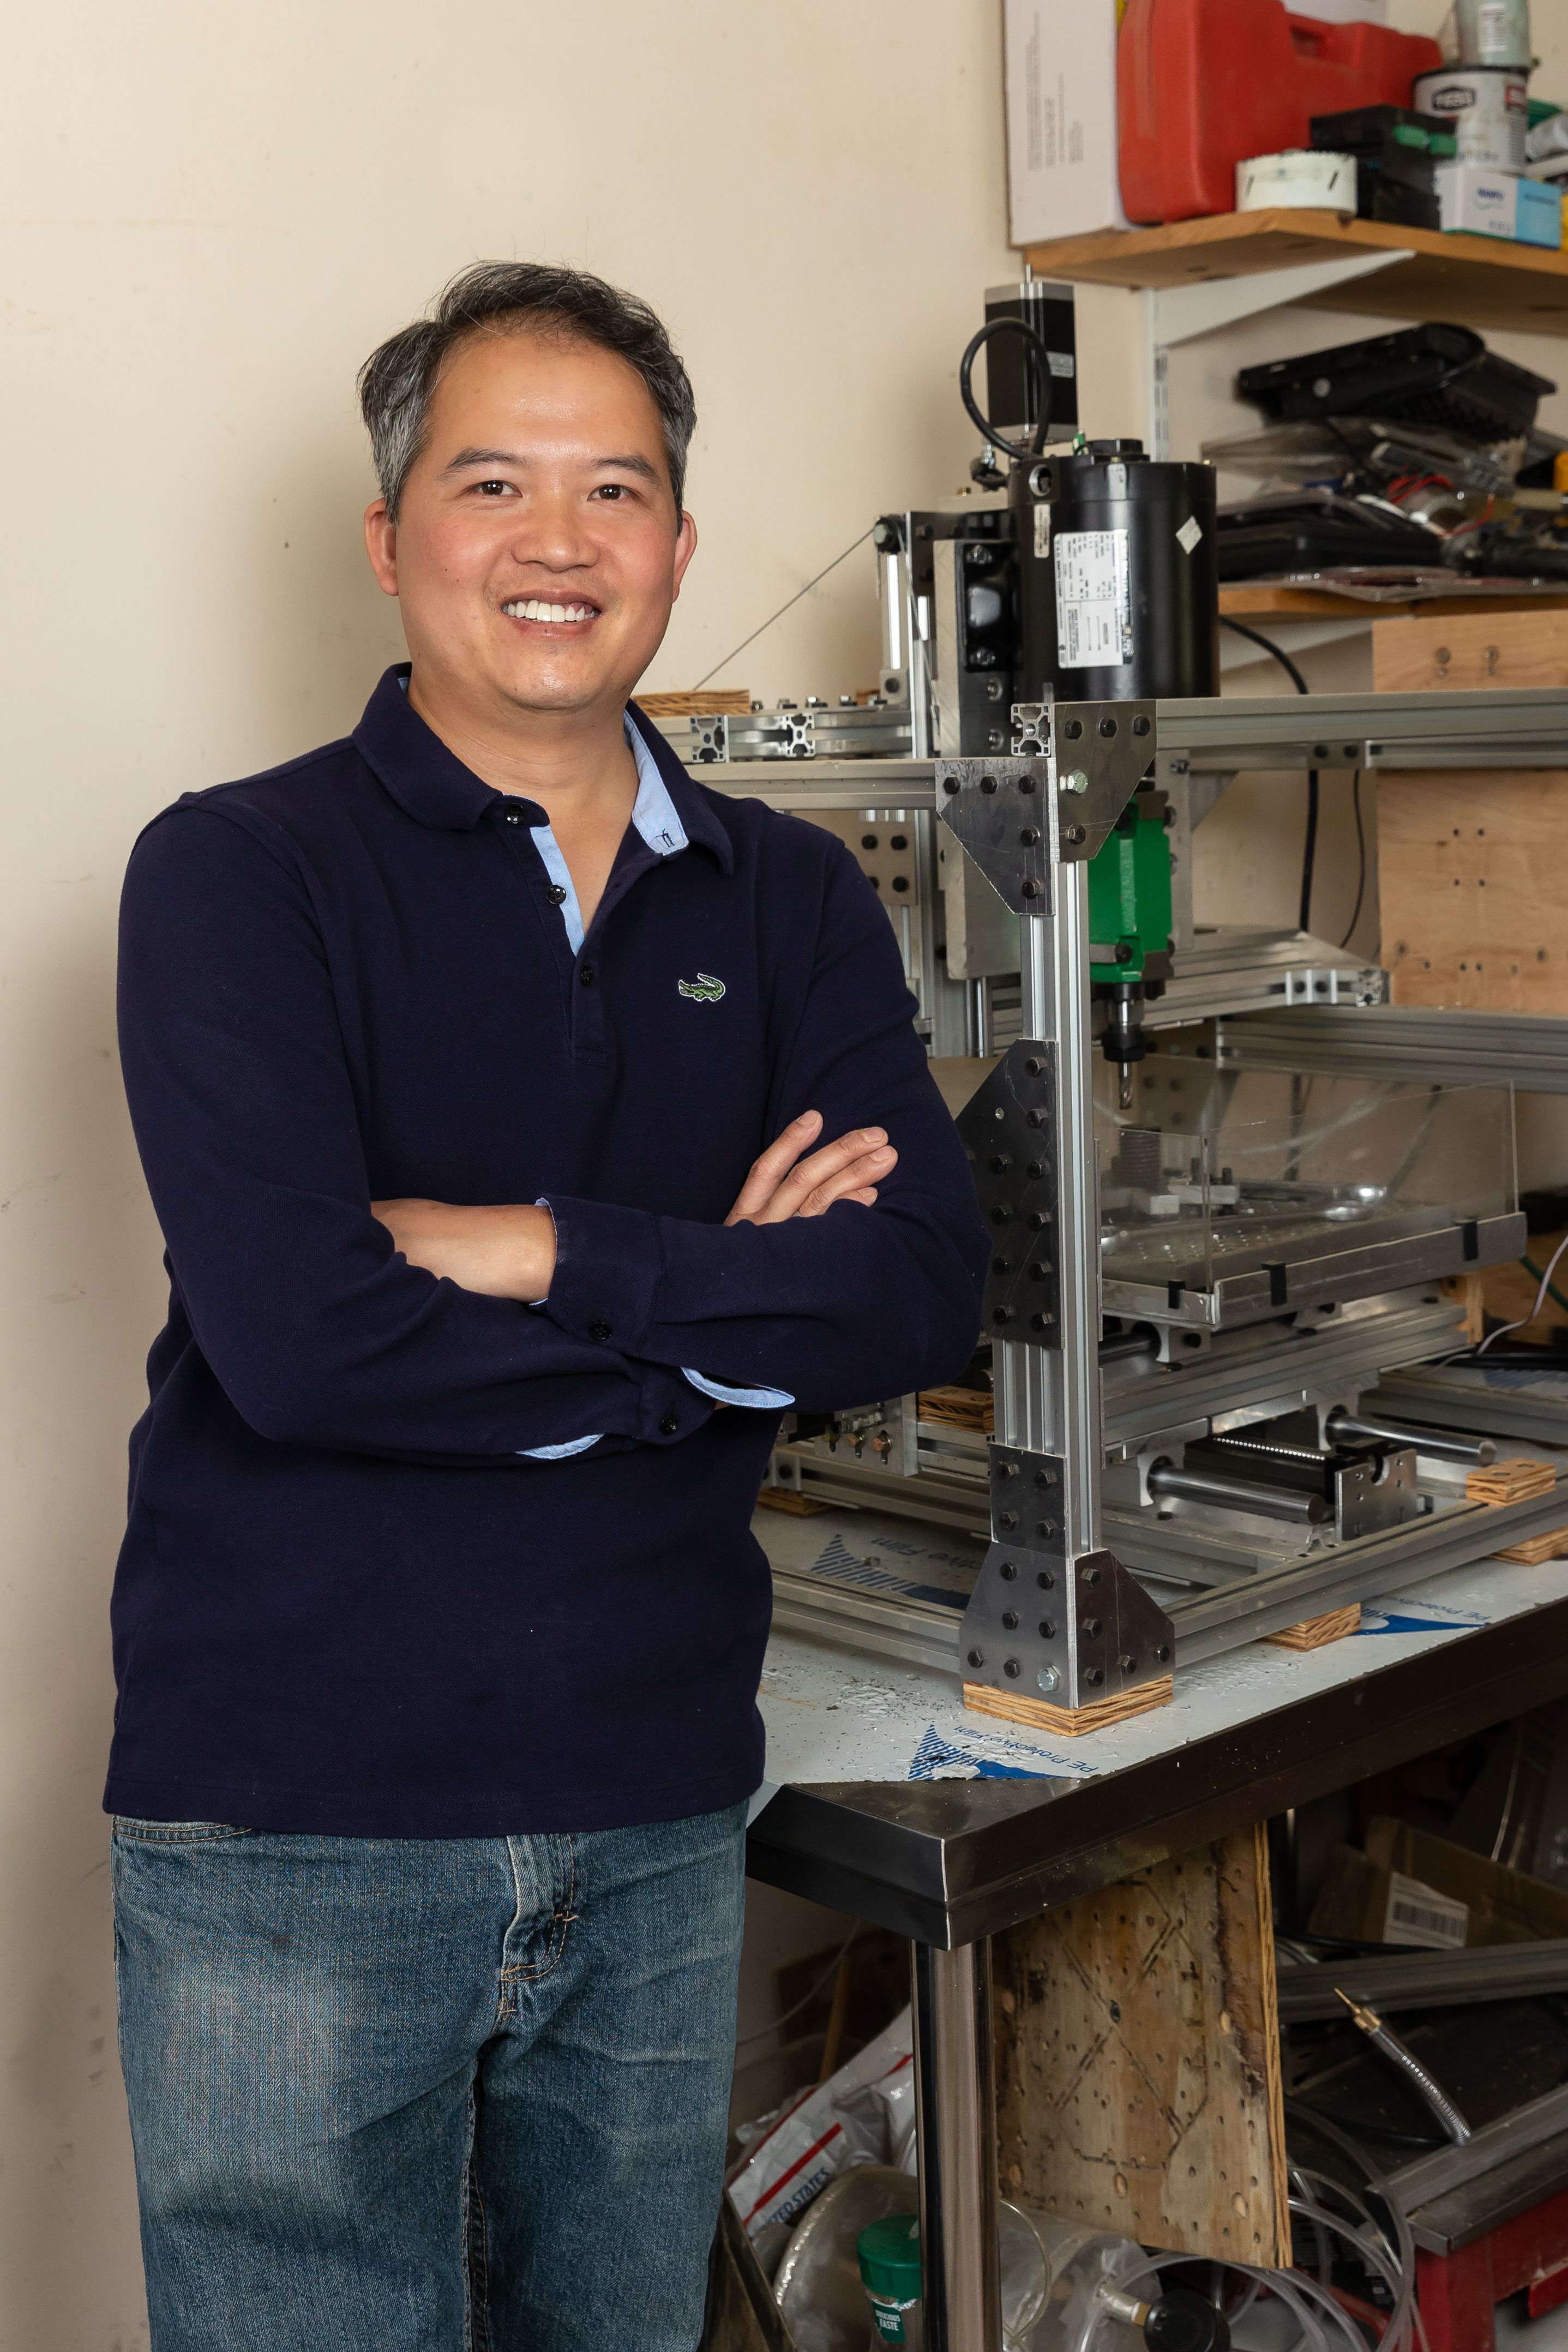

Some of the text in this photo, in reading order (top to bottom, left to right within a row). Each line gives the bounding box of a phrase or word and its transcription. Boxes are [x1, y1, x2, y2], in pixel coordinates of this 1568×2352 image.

[871, 1538, 928, 1556] Film
[1462, 1611, 1493, 1621] PE
[954, 1725, 1099, 1773] PE Protective Film
[791, 2167, 830, 2205] STATES
